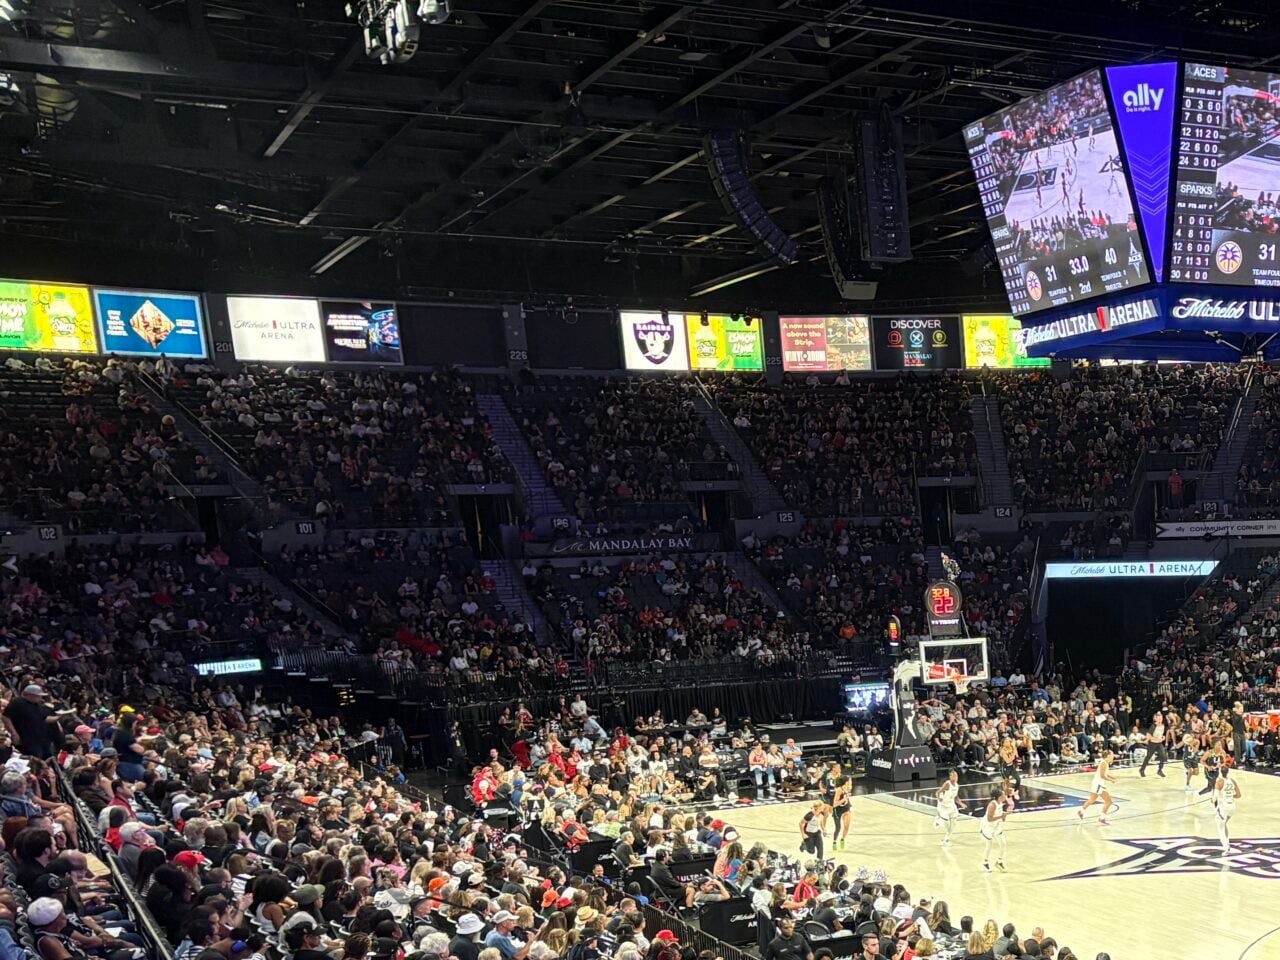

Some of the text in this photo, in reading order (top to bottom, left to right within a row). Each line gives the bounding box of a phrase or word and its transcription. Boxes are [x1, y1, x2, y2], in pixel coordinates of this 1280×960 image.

[1193, 67, 1217, 78] ACES
[1123, 83, 1164, 111] ally
[1185, 99, 1220, 111] 0 3 6 0
[1185, 112, 1220, 124] 7 6 0 1
[1182, 127, 1219, 139] 12 11 2 0
[1180, 142, 1218, 153] 22 6 0 0
[1179, 156, 1216, 168] 24 3 0 0
[1180, 184, 1213, 195] SPARKS
[1178, 216, 1212, 226] 1 0 0 1
[1176, 229, 1211, 239] 4 8 1 0
[1174, 242, 1210, 253] 12 6 0 0
[1258, 244, 1276, 261] 31
[1105, 247, 1117, 265] 40
[1173, 256, 1209, 266] 17 11 3 1
[1068, 255, 1089, 275] 33.0
[1045, 265, 1057, 282] 31
[1171, 270, 1208, 280] 30 4 0 0
[1252, 269, 1269, 277] TEAM
[1079, 281, 1092, 294] 2nd
[1172, 298, 1246, 320] Michelob
[279, 321, 315, 330] ULTRA
[890, 319, 941, 329] DISCOVER
[1022, 301, 1151, 347] Michelob ULTRA ARENA
[261, 332, 294, 340] ARENA
[216, 342, 232, 352] 201
[766, 357, 782, 365] 225
[996, 508, 1011, 517] 124
[1203, 502, 1217, 512] 123
[779, 512, 793, 522] 125
[40, 527, 57, 540] 102
[298, 523, 313, 534] 101
[589, 538, 691, 550] MANDALAY BAY
[1070, 563, 1195, 576] Michelob ULTRA ARENA
[934, 597, 954, 614] 22
